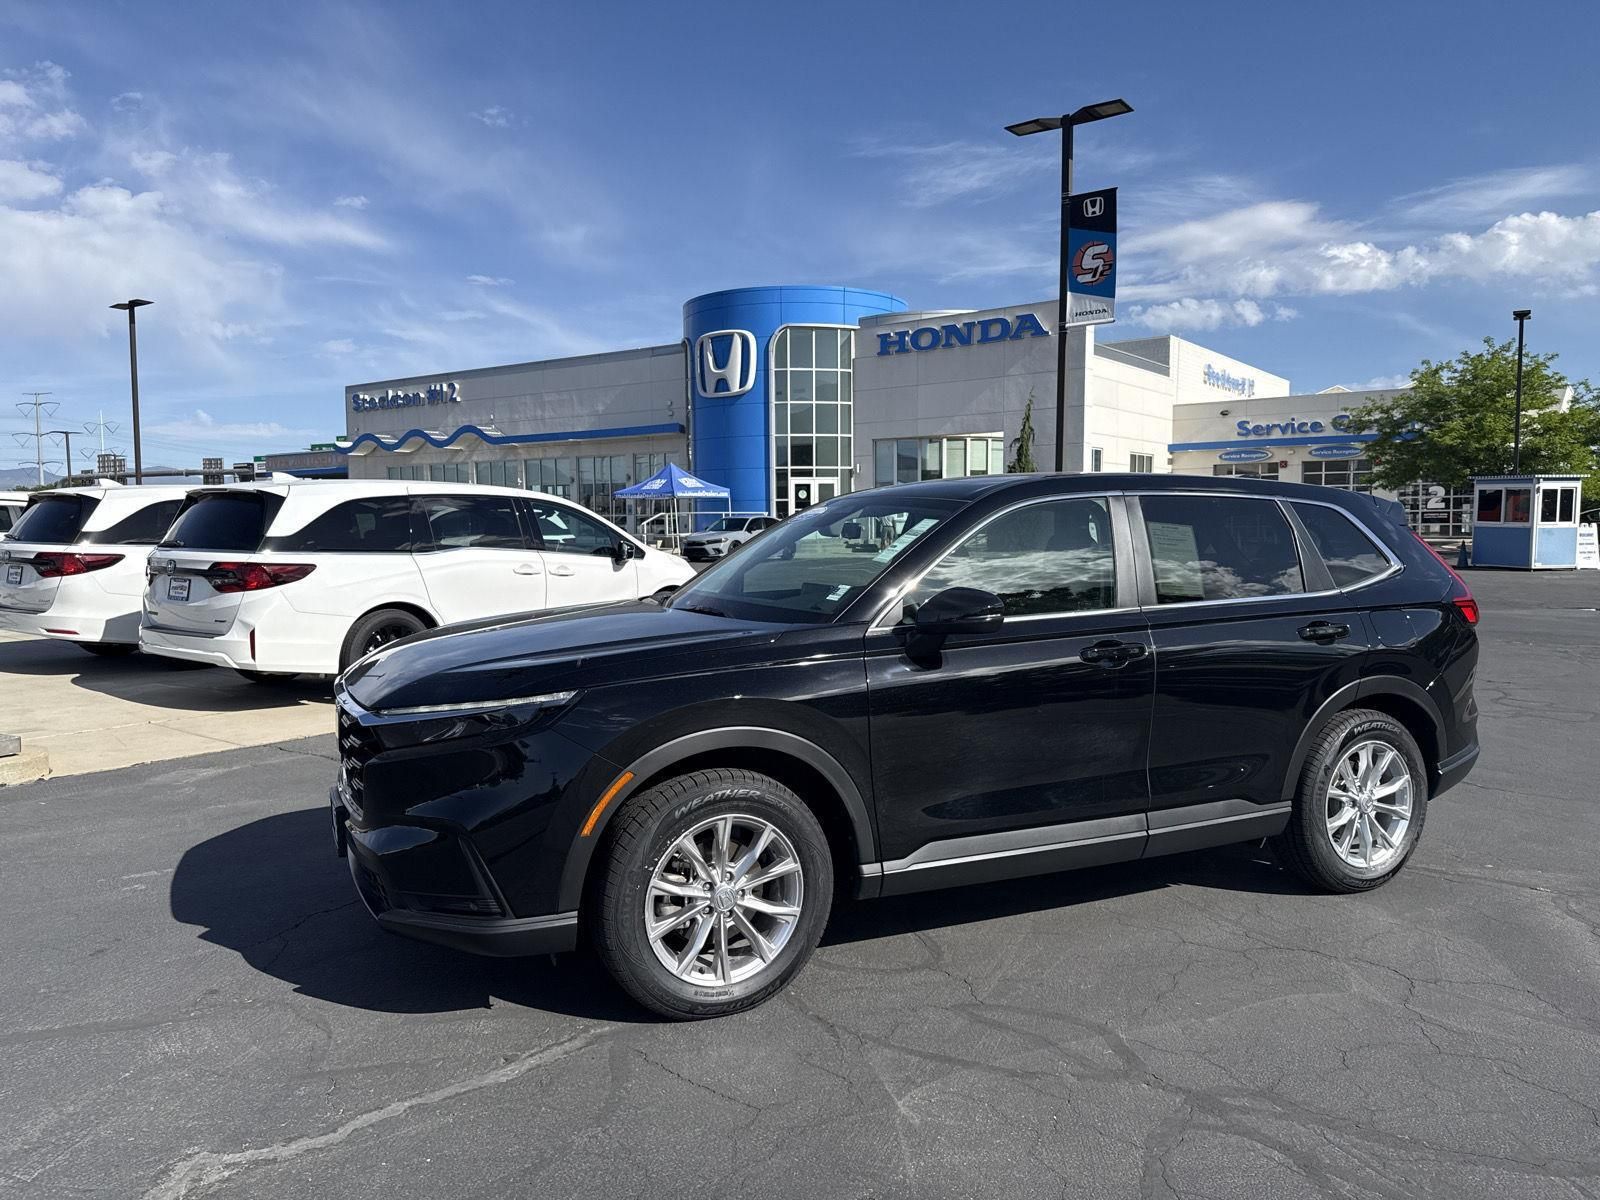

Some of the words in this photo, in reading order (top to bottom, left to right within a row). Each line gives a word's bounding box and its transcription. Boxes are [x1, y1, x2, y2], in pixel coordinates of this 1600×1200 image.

[1074, 308, 1107, 317] HONDA
[876, 313, 1051, 356] HONDA
[352, 388, 426, 412] Stockton
[1236, 418, 1325, 437] Service
[1427, 485, 1445, 509] 2
[1354, 721, 1401, 735] WEATHER
[674, 788, 761, 819] WEATHER
